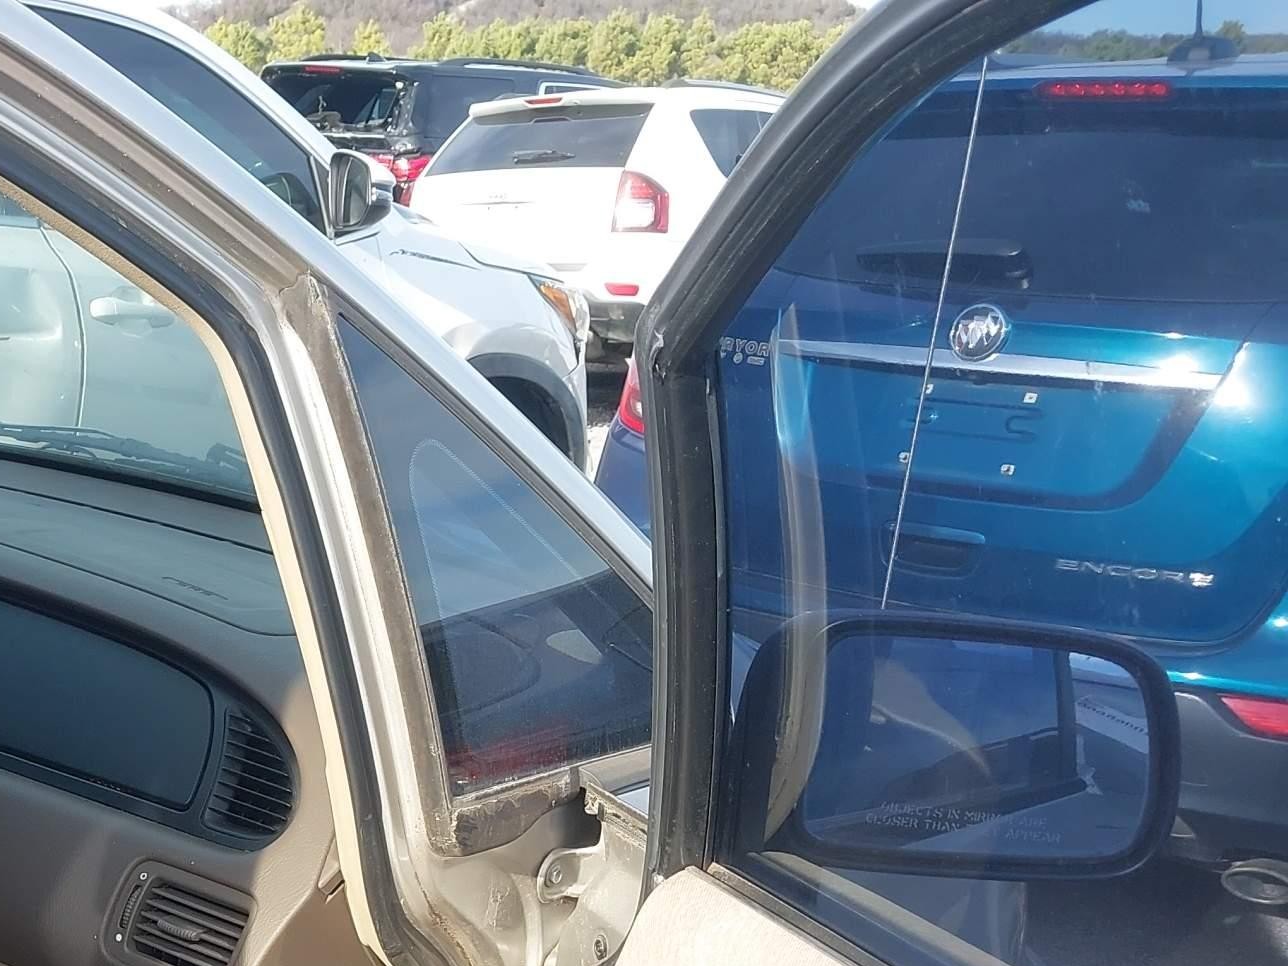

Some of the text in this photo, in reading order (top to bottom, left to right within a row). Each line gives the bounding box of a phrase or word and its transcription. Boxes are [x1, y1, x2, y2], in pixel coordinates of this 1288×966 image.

[880, 801, 943, 819] OBJECTS
[947, 809, 961, 820] IN
[865, 813, 918, 829] CLOSER
[924, 819, 961, 833] THAN
